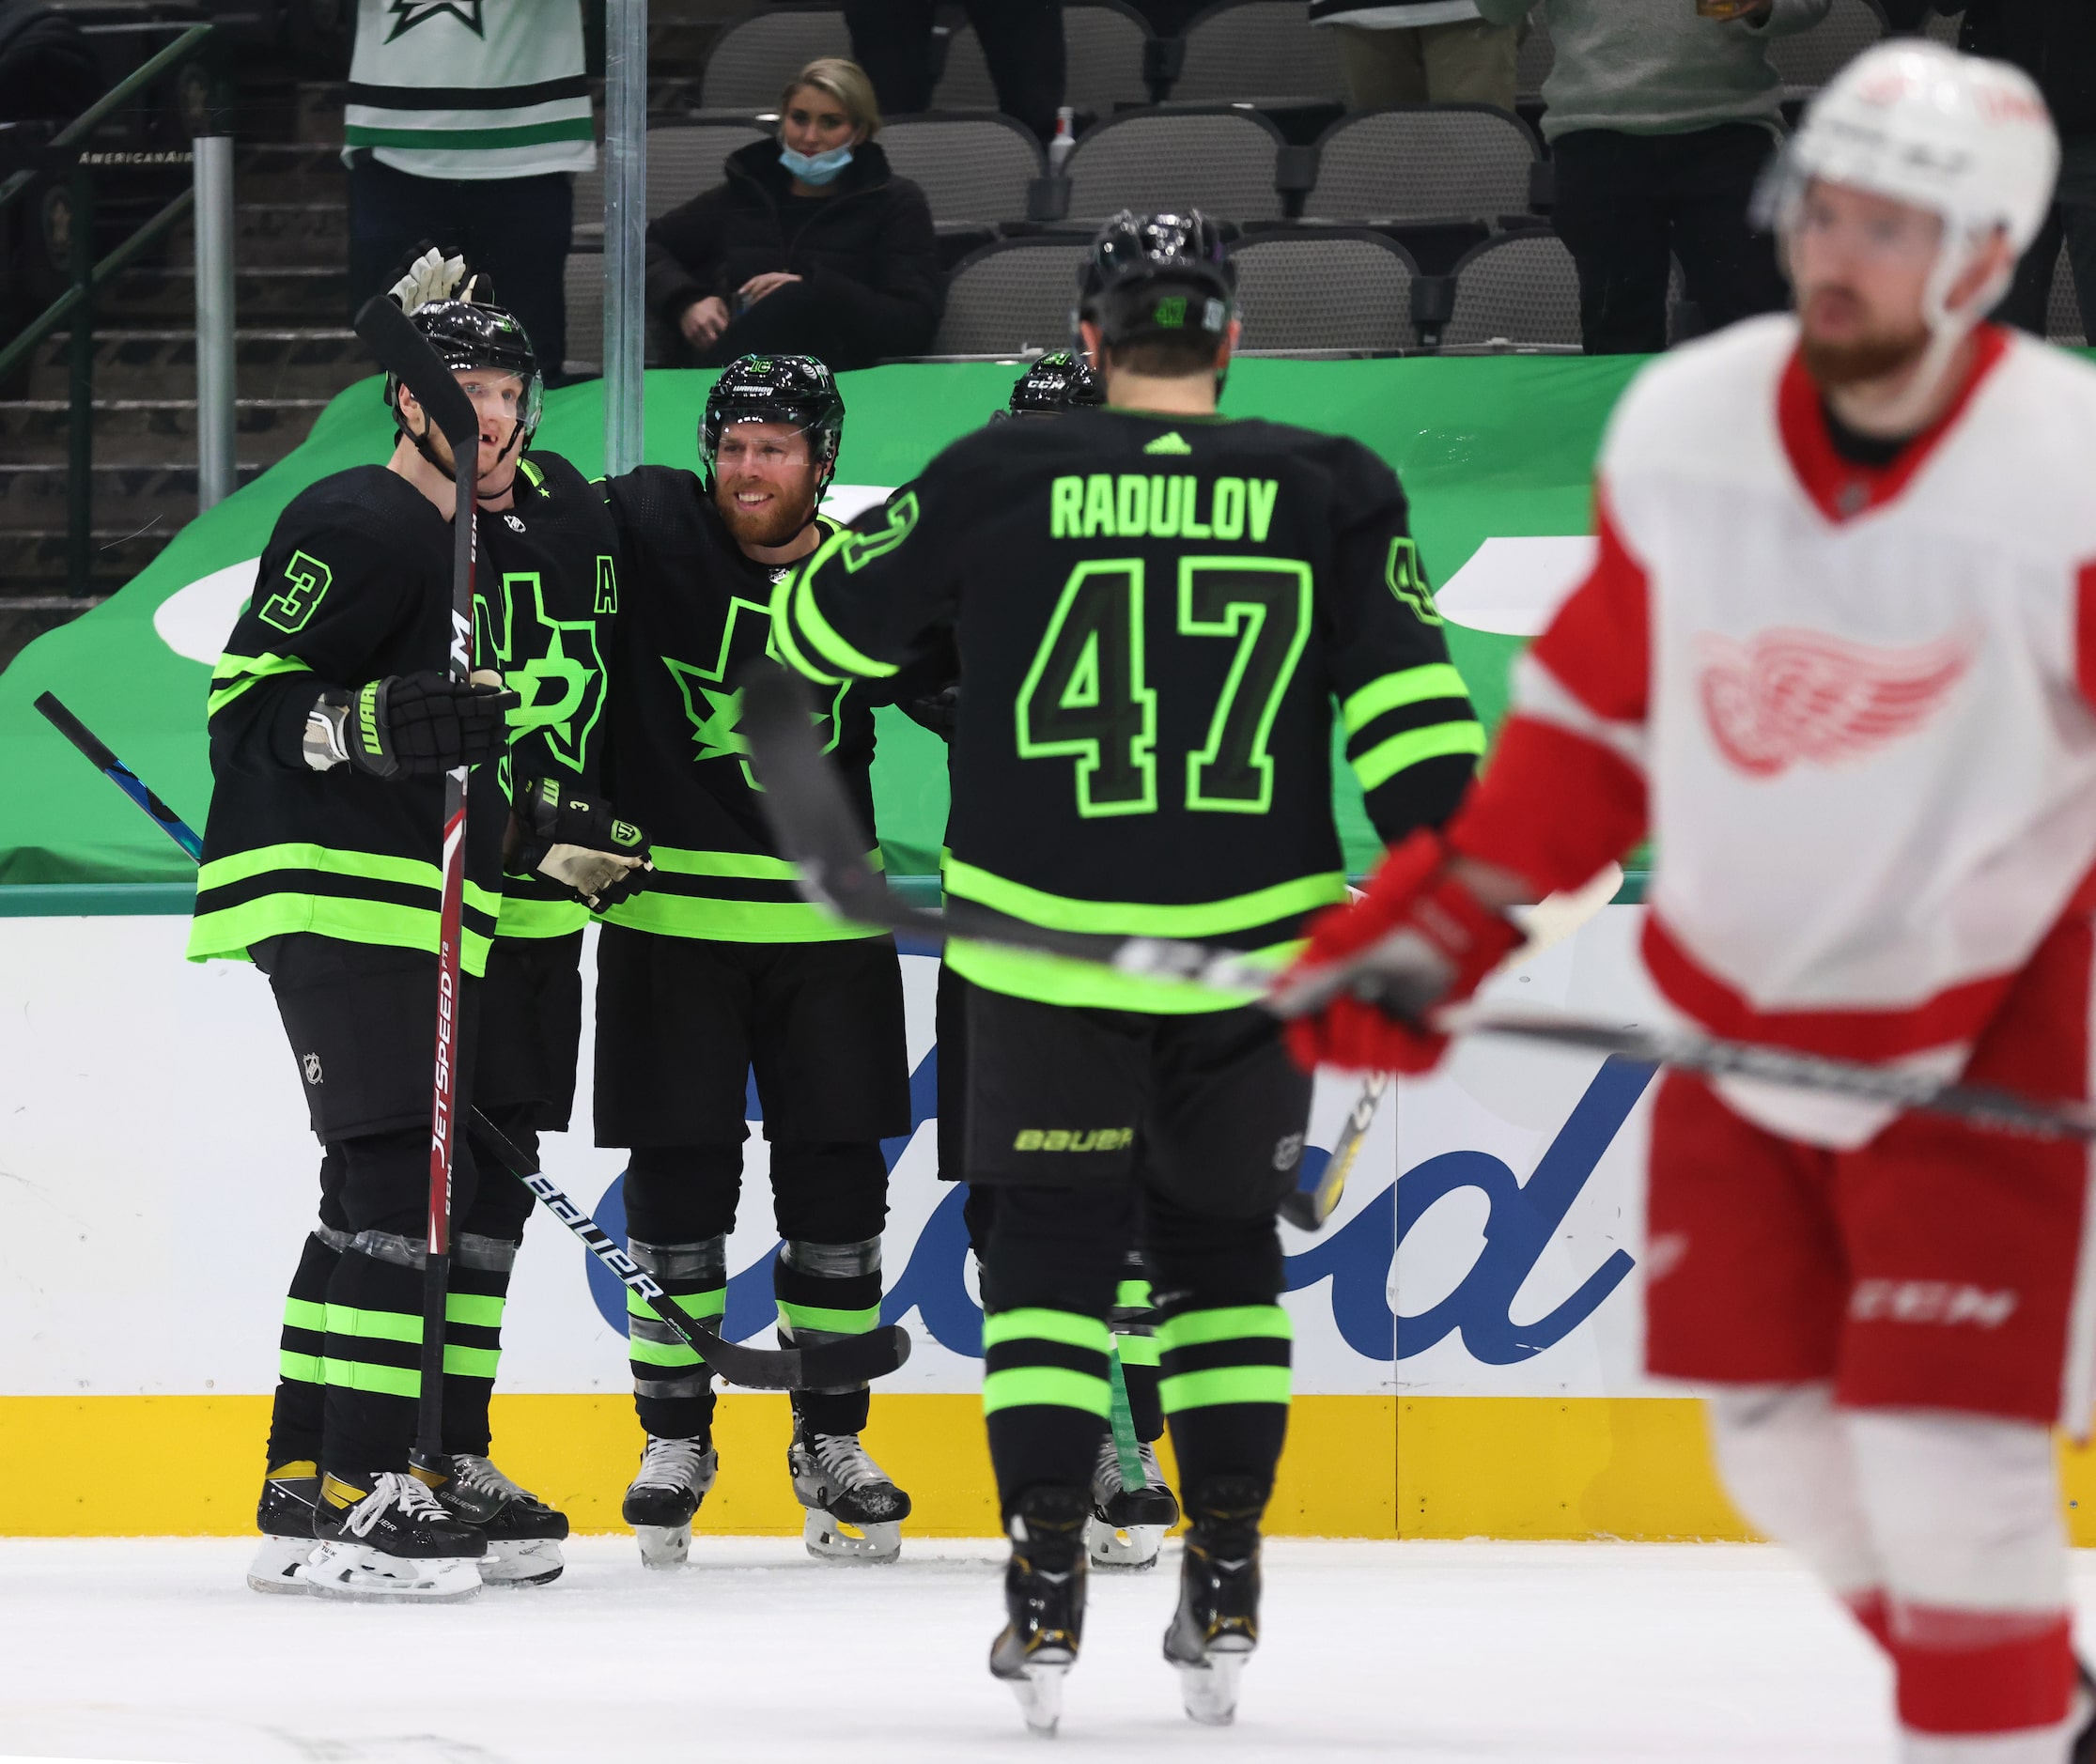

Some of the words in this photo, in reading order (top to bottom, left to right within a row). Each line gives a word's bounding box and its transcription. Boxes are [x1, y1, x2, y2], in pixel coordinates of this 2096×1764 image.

[1027, 379, 1066, 390] CCM
[1050, 474, 1279, 543] RADULOV
[257, 549, 333, 634] 3
[594, 555, 617, 613] A
[1015, 556, 1313, 818] 47
[569, 800, 590, 812] 3
[441, 941, 450, 968] FT2
[432, 973, 454, 1168] JETSPEED
